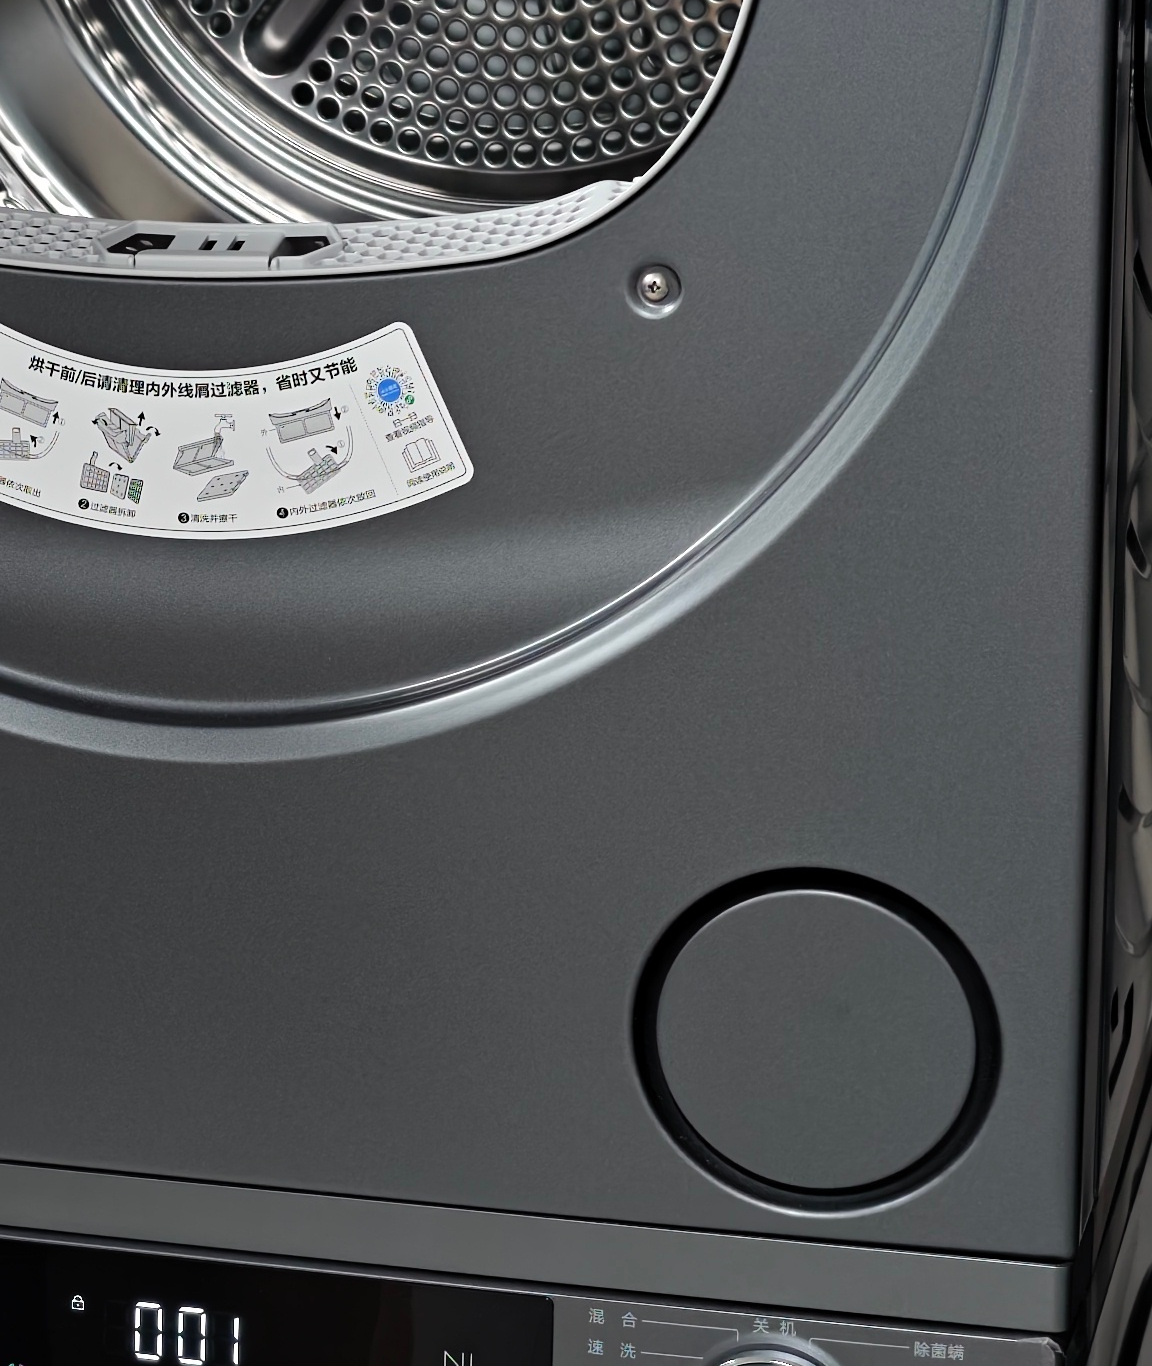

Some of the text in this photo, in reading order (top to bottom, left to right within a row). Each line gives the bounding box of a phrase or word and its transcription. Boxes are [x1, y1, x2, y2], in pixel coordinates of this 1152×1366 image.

[588, 1307, 638, 1329] 混合
[752, 1318, 797, 1337] 关机
[134, 1301, 241, 1366] 001
[587, 1338, 636, 1359] 速洗
[914, 1341, 965, 1361] 除菌螨
